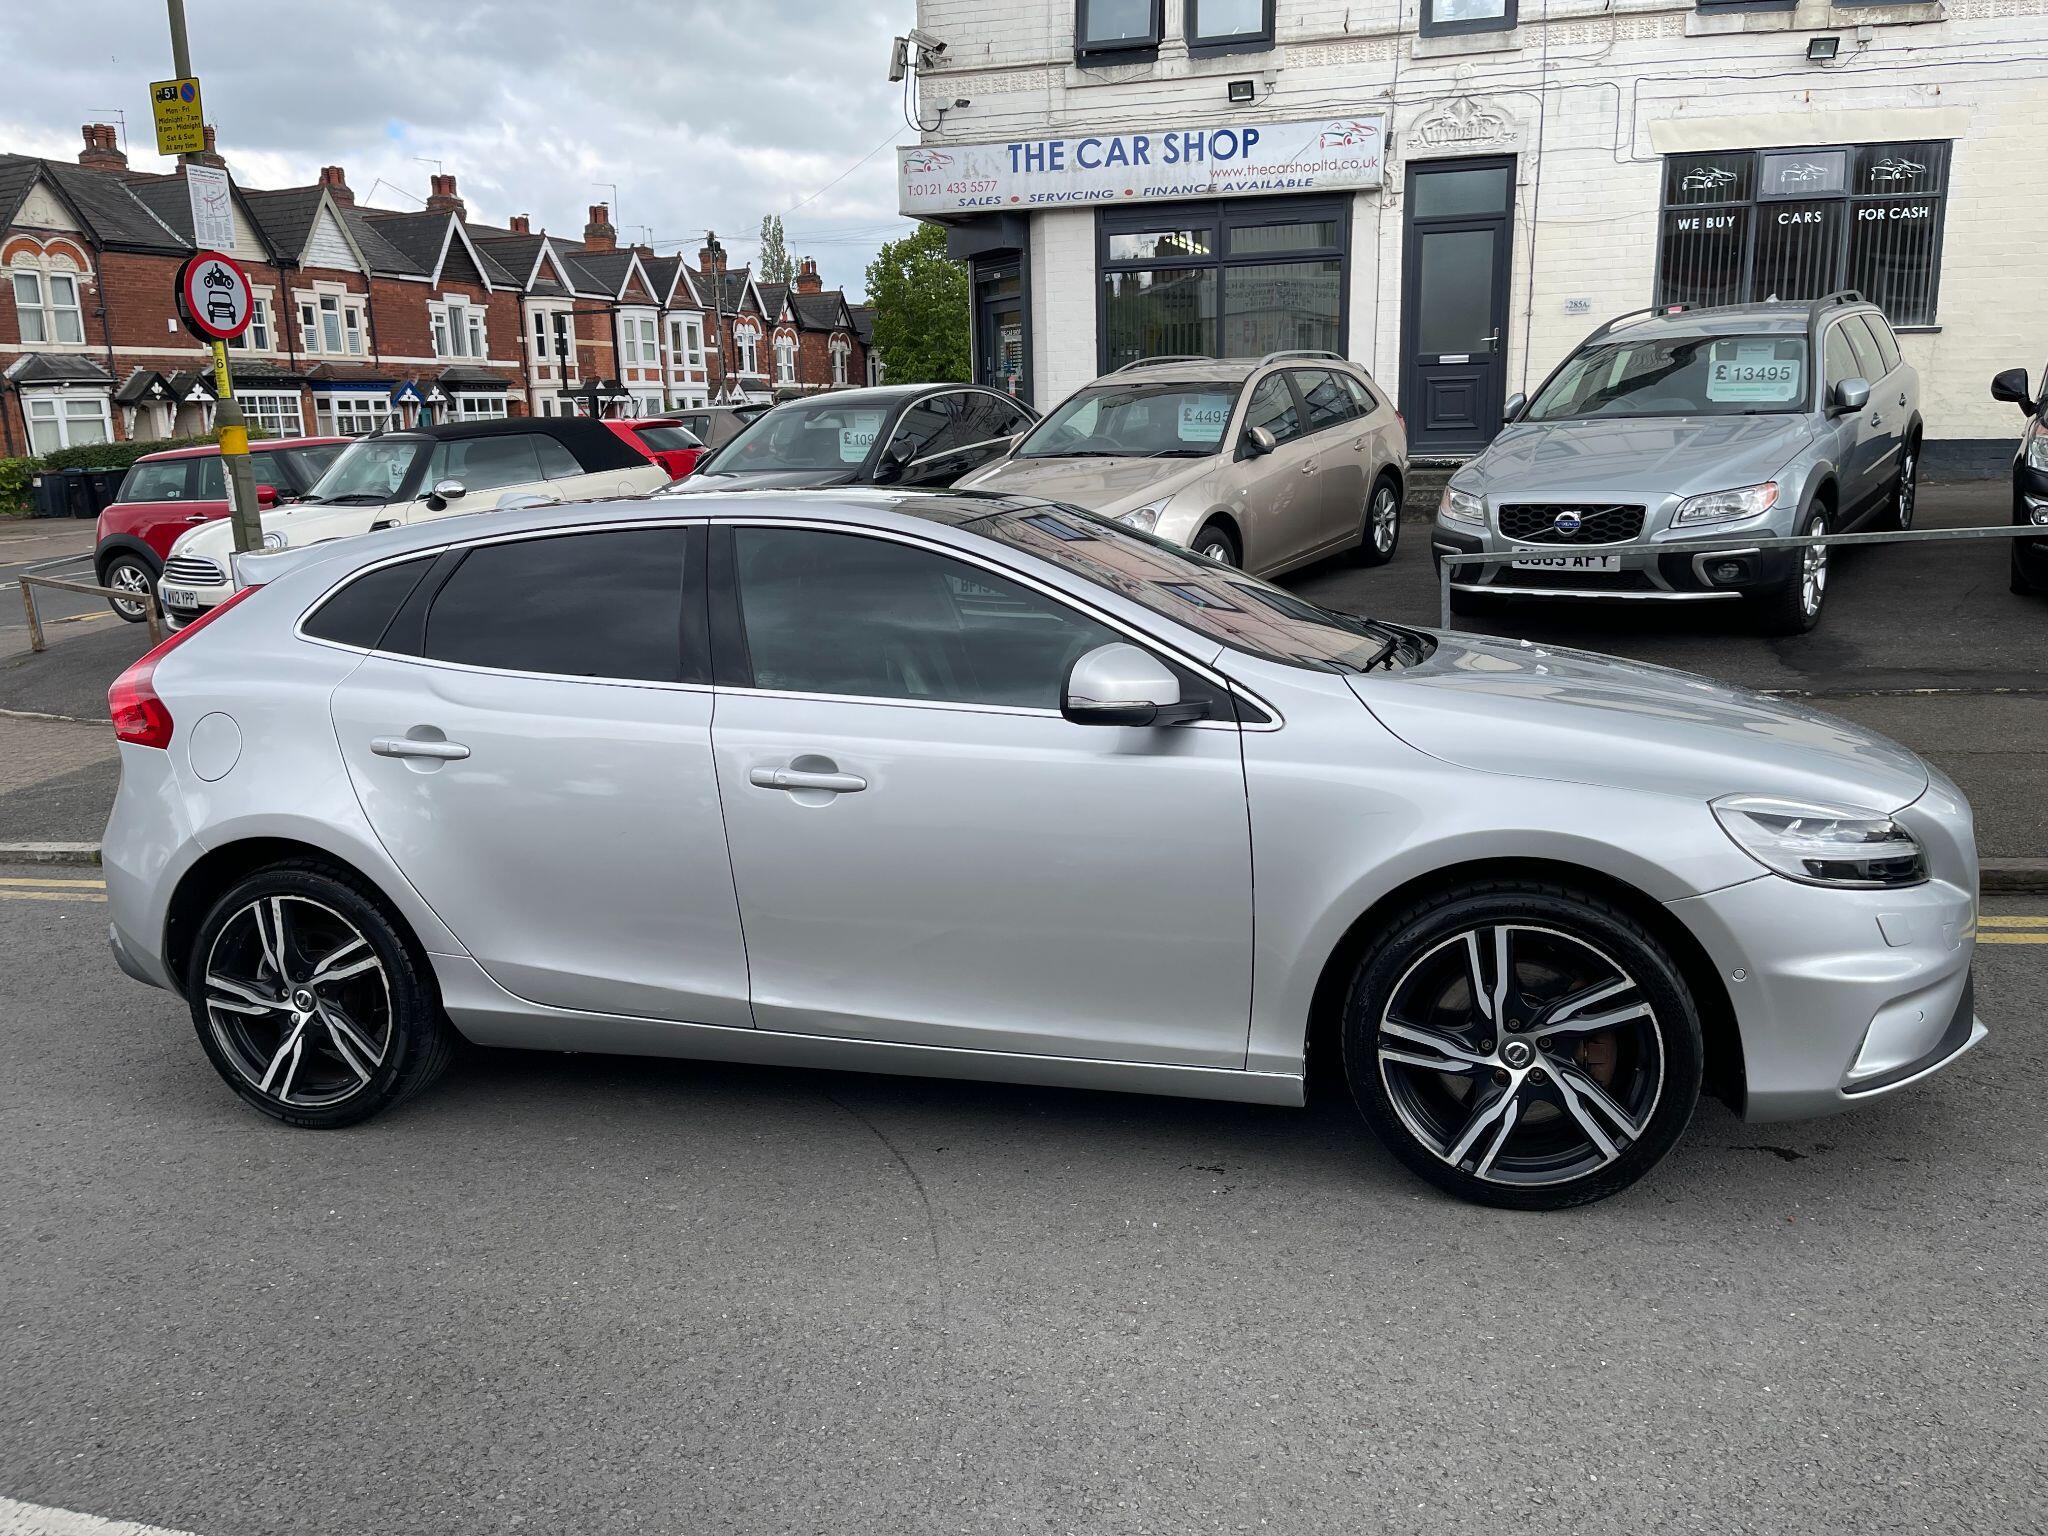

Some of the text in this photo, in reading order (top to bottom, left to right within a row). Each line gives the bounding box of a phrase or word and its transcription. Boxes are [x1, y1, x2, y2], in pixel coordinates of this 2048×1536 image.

[159, 117, 183, 125] Midnight
[1008, 128, 1259, 173] THE CAR SHOP
[1209, 156, 1379, 178] www.thecarshopltd.co.uk
[907, 180, 998, 196] T:0121 433 5577
[958, 177, 1314, 207] SALES SERVICING FINANCE AVAILABLE
[1677, 206, 1929, 230] WE BUY CARS FOR CASH
[216, 358, 224, 369] 6
